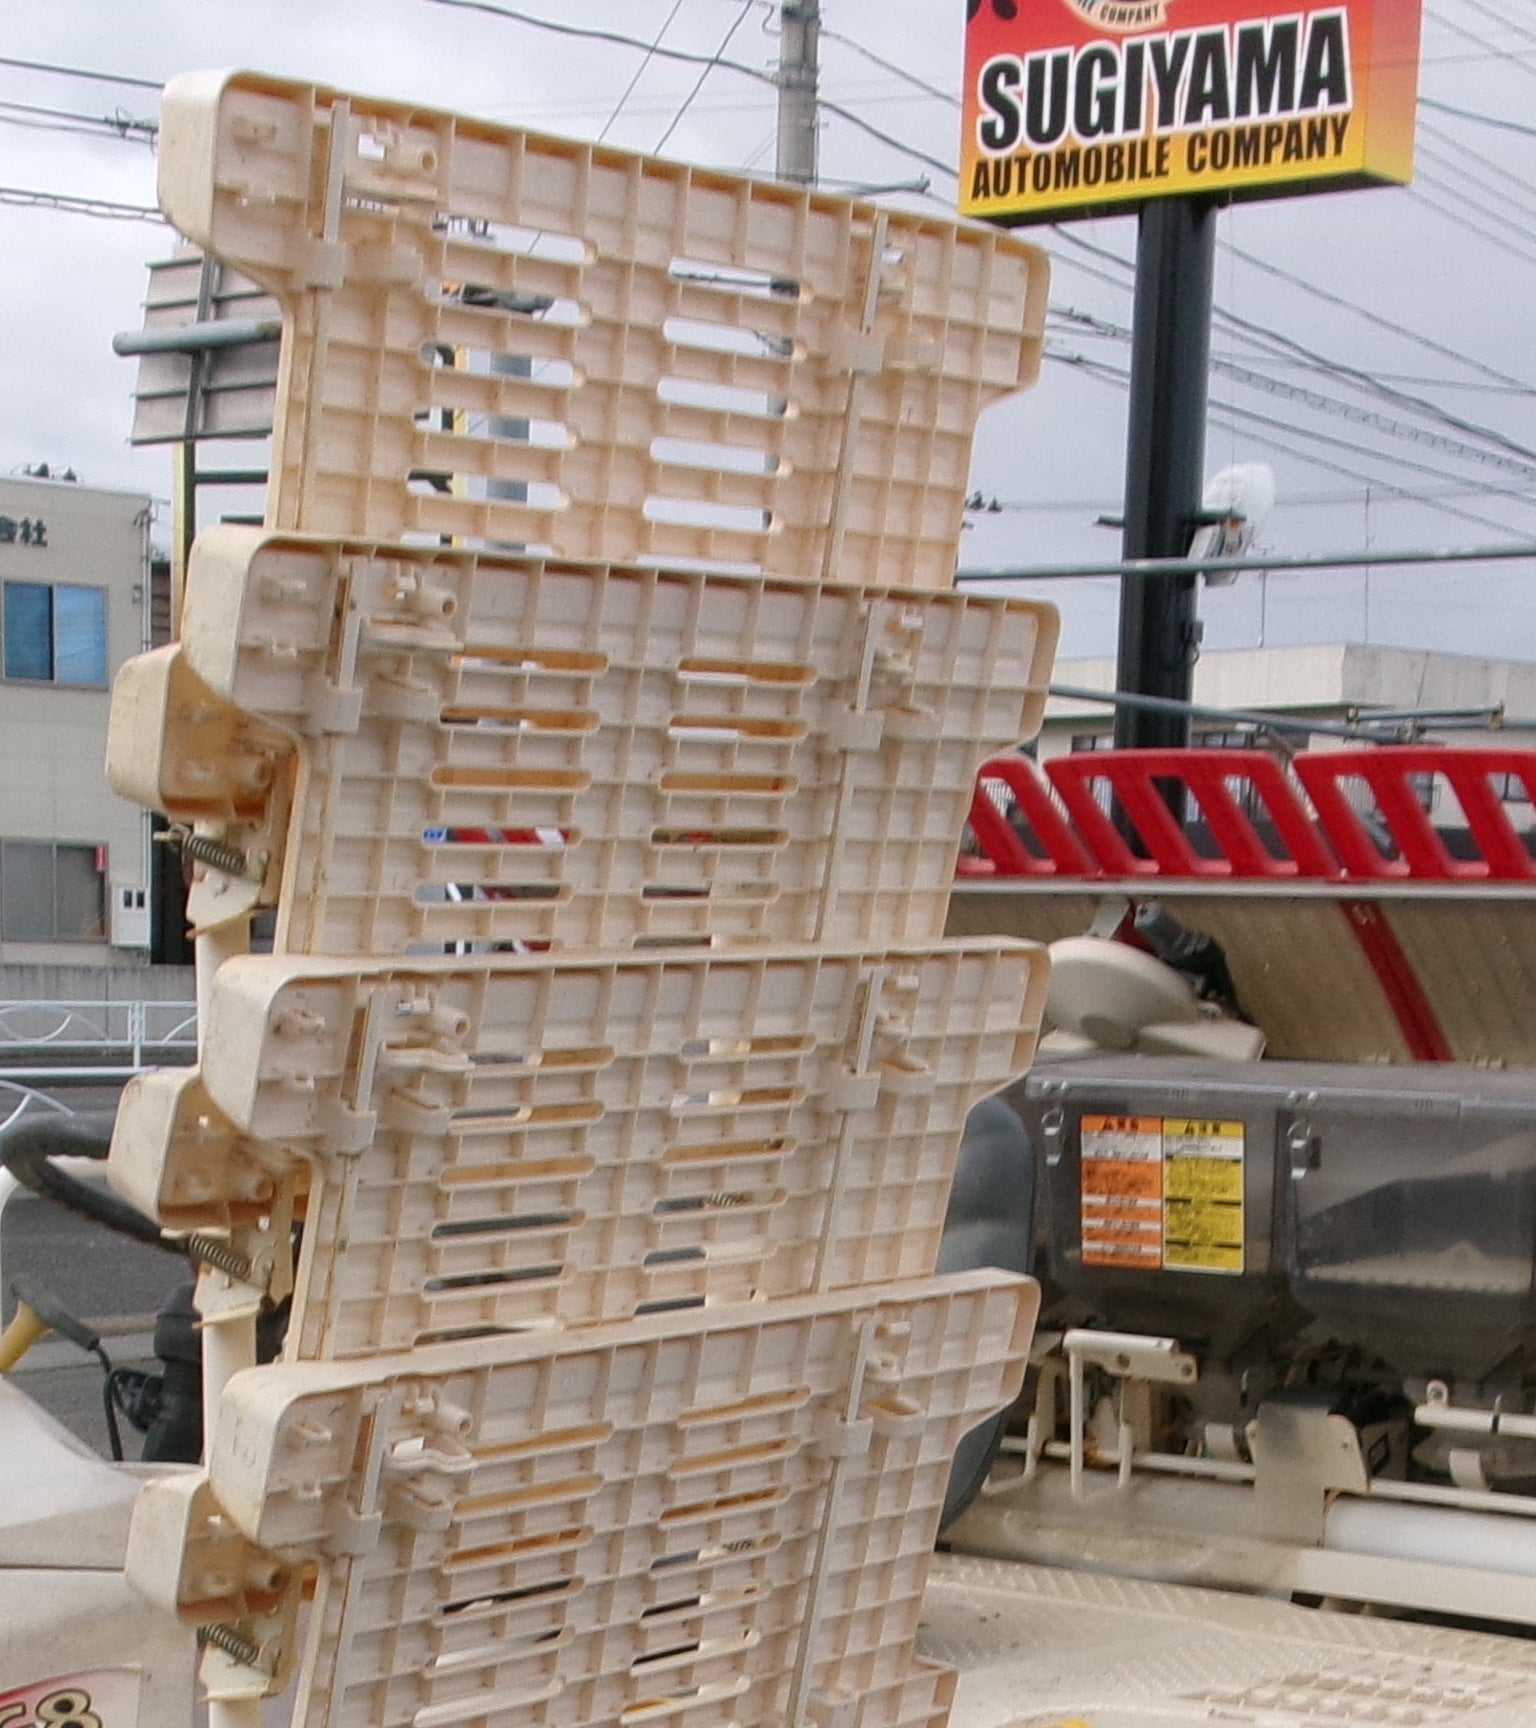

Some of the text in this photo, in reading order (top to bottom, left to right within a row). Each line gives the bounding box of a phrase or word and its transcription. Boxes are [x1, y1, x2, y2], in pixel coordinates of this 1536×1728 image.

[978, 11, 1350, 152] SUGIYAMA
[971, 113, 1351, 200] AUTOMOBILE COMPANY
